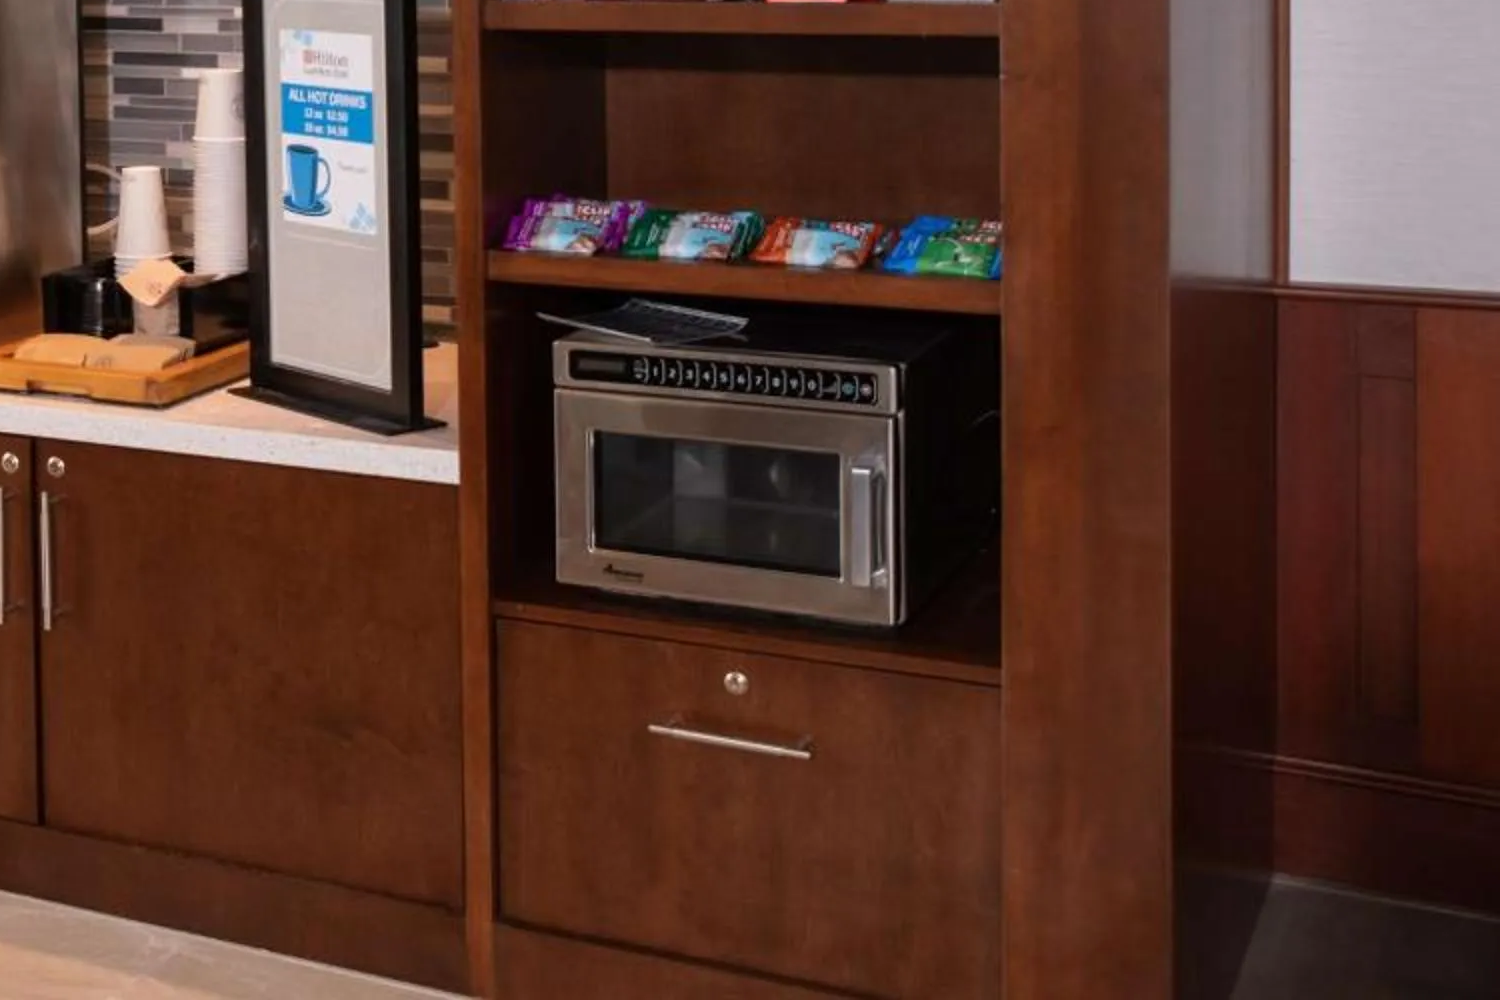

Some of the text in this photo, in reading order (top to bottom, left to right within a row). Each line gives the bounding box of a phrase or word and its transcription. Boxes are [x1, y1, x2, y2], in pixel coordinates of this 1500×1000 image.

[312, 50, 349, 67] Hilton
[288, 87, 367, 110] ALL HOT DRINKS
